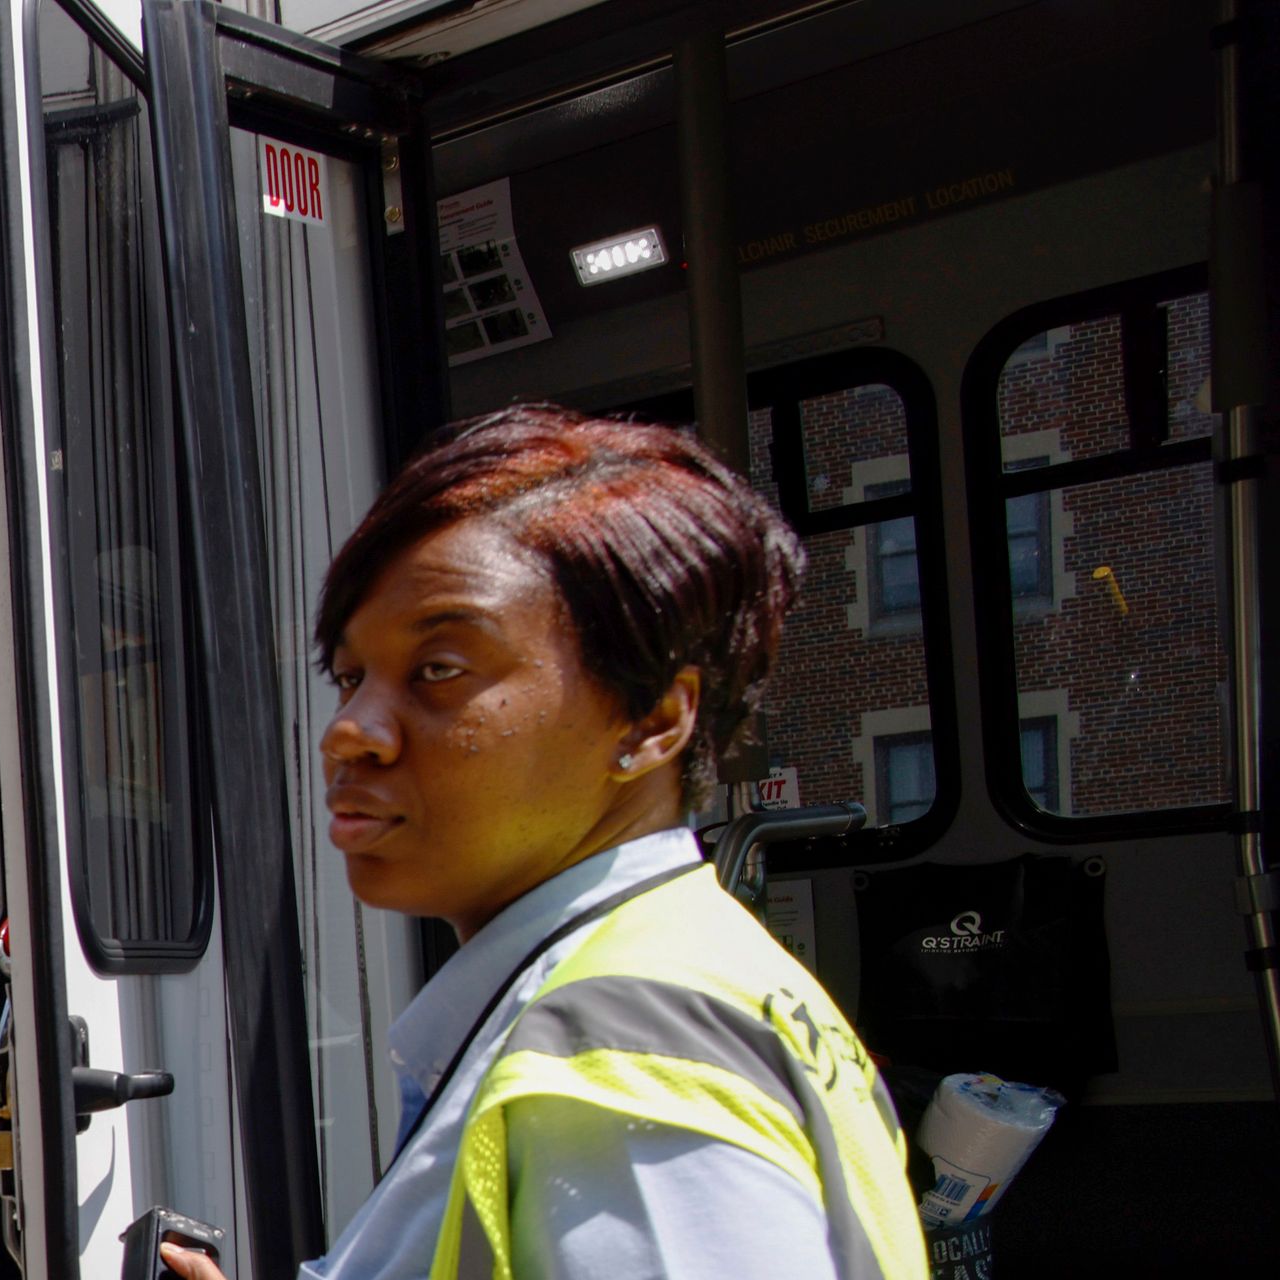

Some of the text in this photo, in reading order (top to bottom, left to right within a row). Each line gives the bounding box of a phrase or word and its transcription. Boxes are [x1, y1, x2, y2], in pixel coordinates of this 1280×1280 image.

[265, 144, 323, 221] DOOR
[737, 167, 1016, 264] LCHAIR SECUREMENT LOCATION
